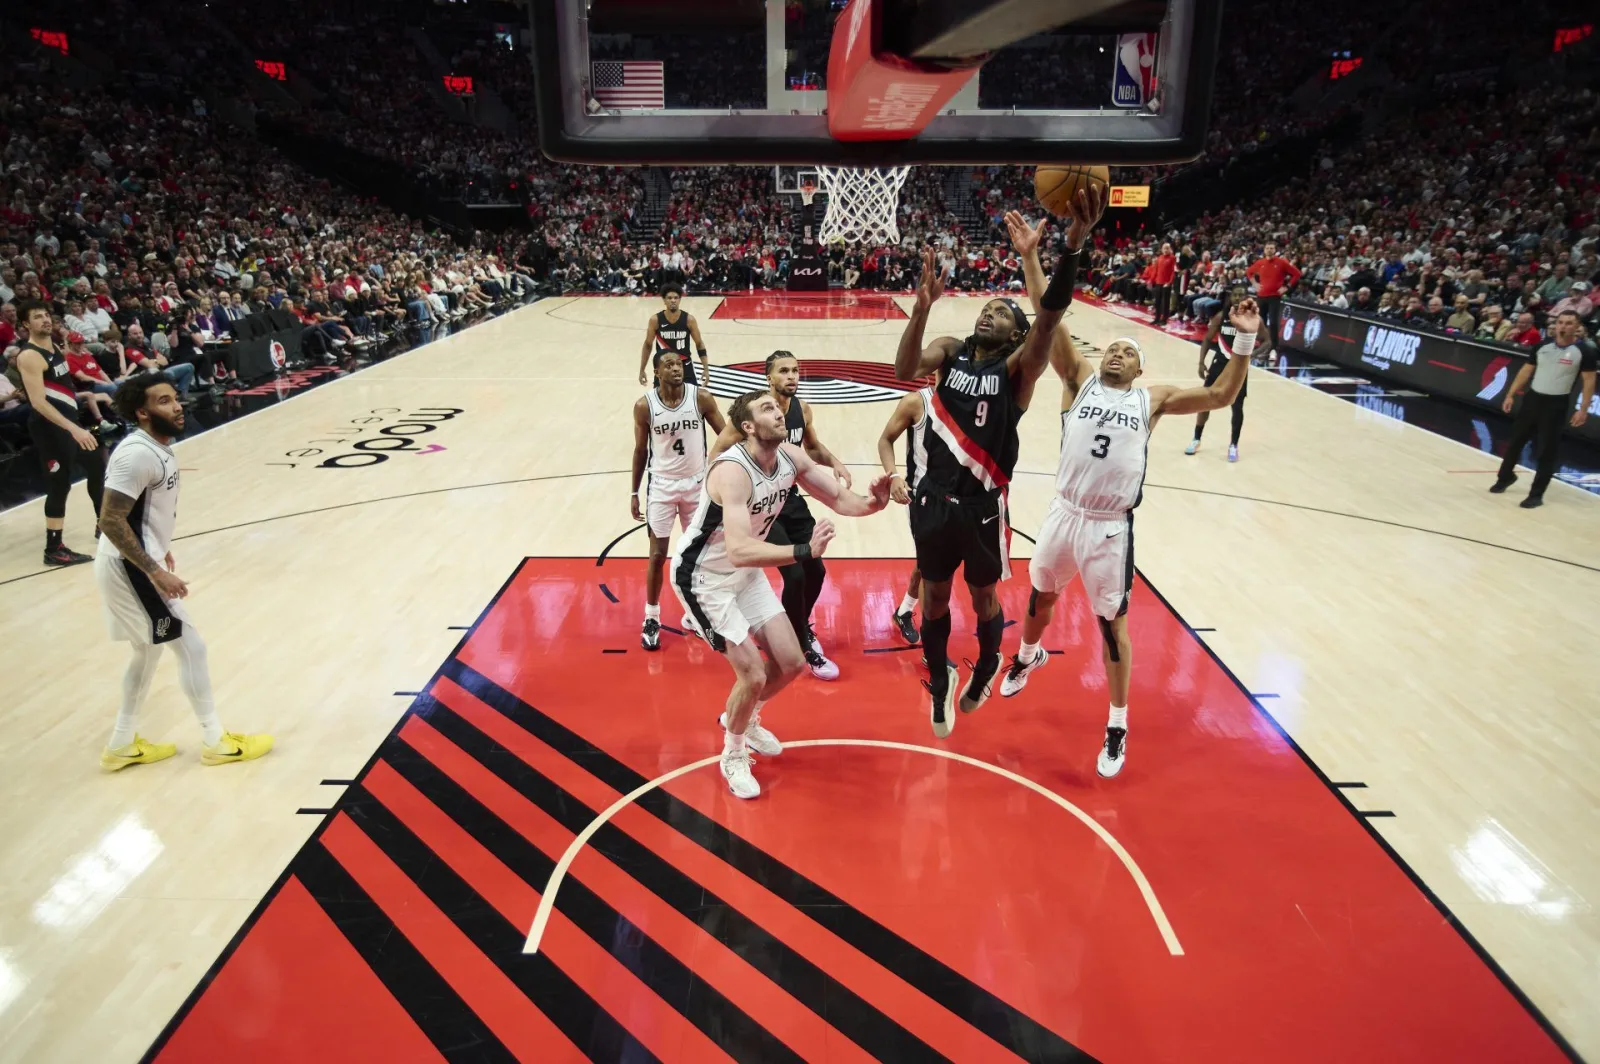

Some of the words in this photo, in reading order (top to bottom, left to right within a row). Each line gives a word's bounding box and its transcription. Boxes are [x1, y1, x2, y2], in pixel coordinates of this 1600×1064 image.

[1118, 85, 1136, 100] NBA
[660, 330, 687, 340] PORTLAND
[676, 339, 686, 350] 00
[1370, 327, 1421, 365] PLAYOFFS
[944, 367, 999, 397] PORTLND
[974, 400, 988, 427] 9
[1078, 406, 1140, 432] SPURS
[653, 419, 699, 437] SPURS
[672, 438, 685, 456] 4
[1091, 434, 1111, 459] 3
[758, 514, 776, 536] 7
